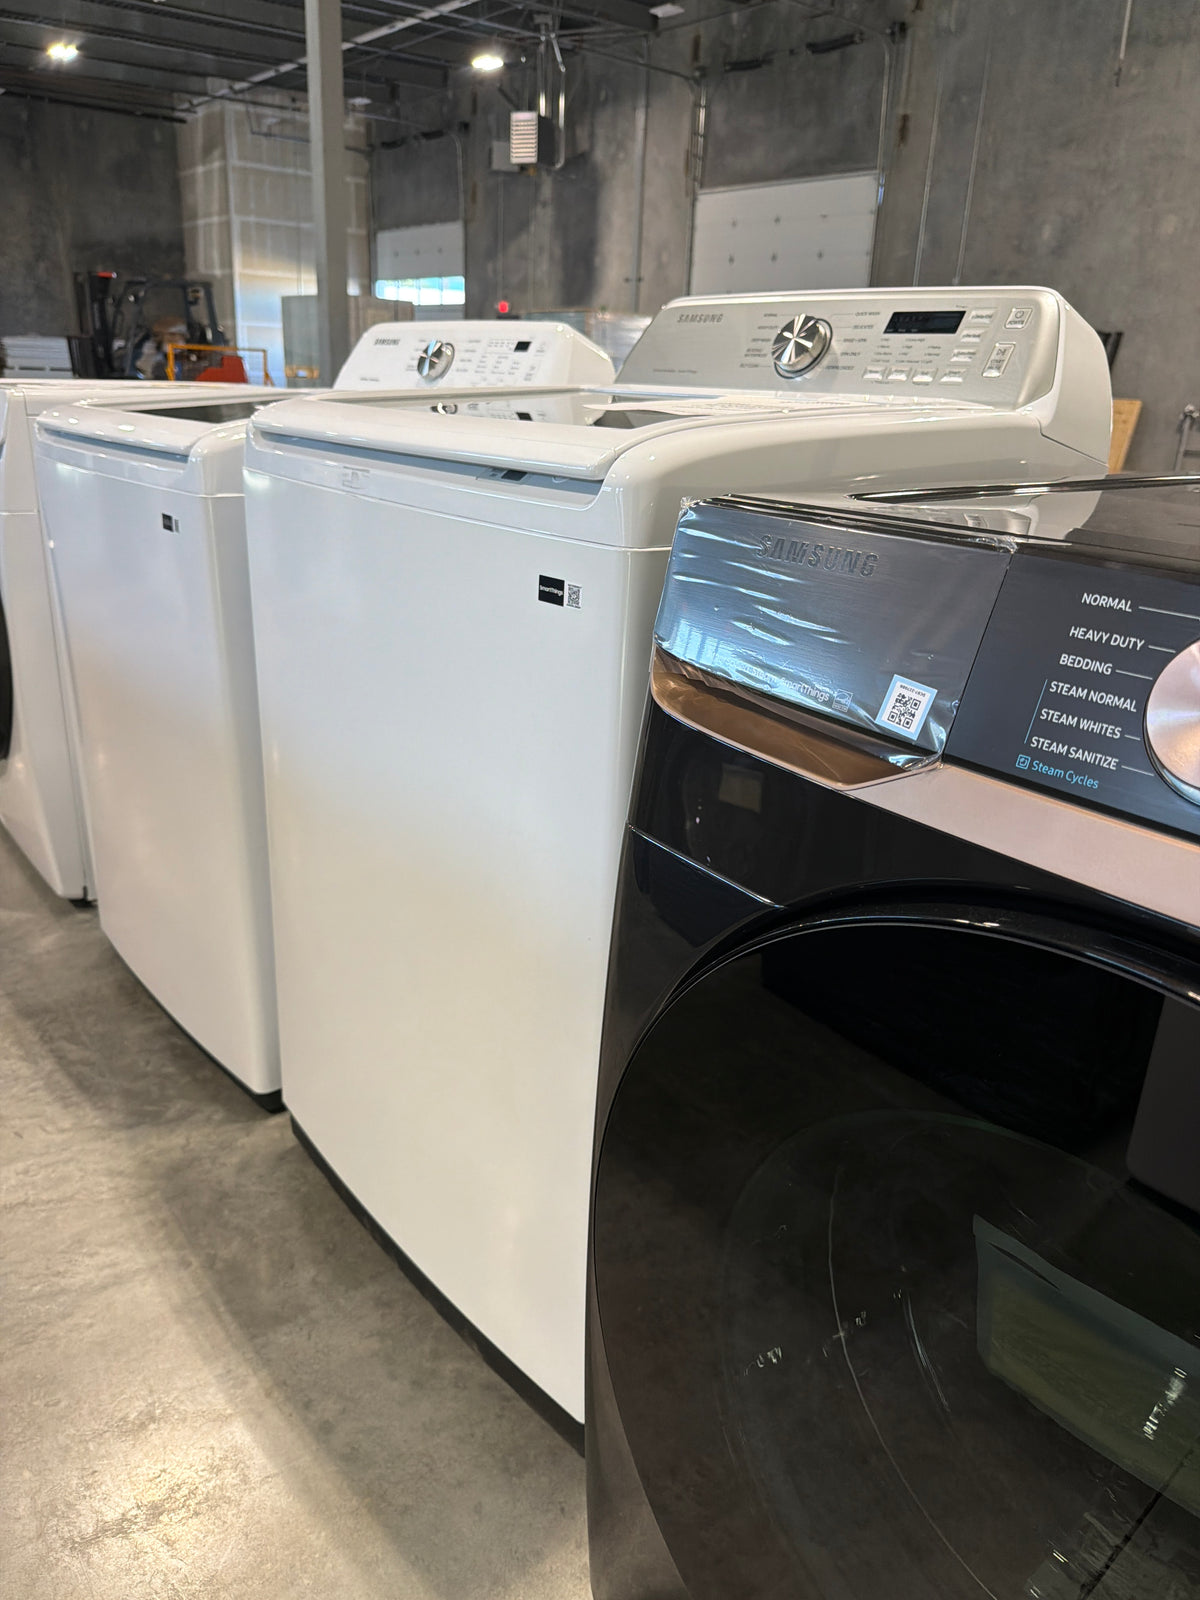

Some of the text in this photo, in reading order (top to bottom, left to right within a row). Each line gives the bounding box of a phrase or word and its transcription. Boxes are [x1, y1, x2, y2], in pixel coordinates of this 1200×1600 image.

[677, 313, 724, 324] SAMSUNG
[756, 534, 879, 578] SAMSUNG
[1081, 592, 1133, 613] NORMAL
[1069, 625, 1145, 651] HEAVY DUTY
[1059, 653, 1113, 675] BEDDING
[1049, 680, 1137, 713] STEAM NORMAL
[1040, 708, 1122, 739] STEAM WHITES
[1030, 736, 1120, 771] STEAM SANITIZE
[1031, 760, 1099, 790] Steam Cycles
